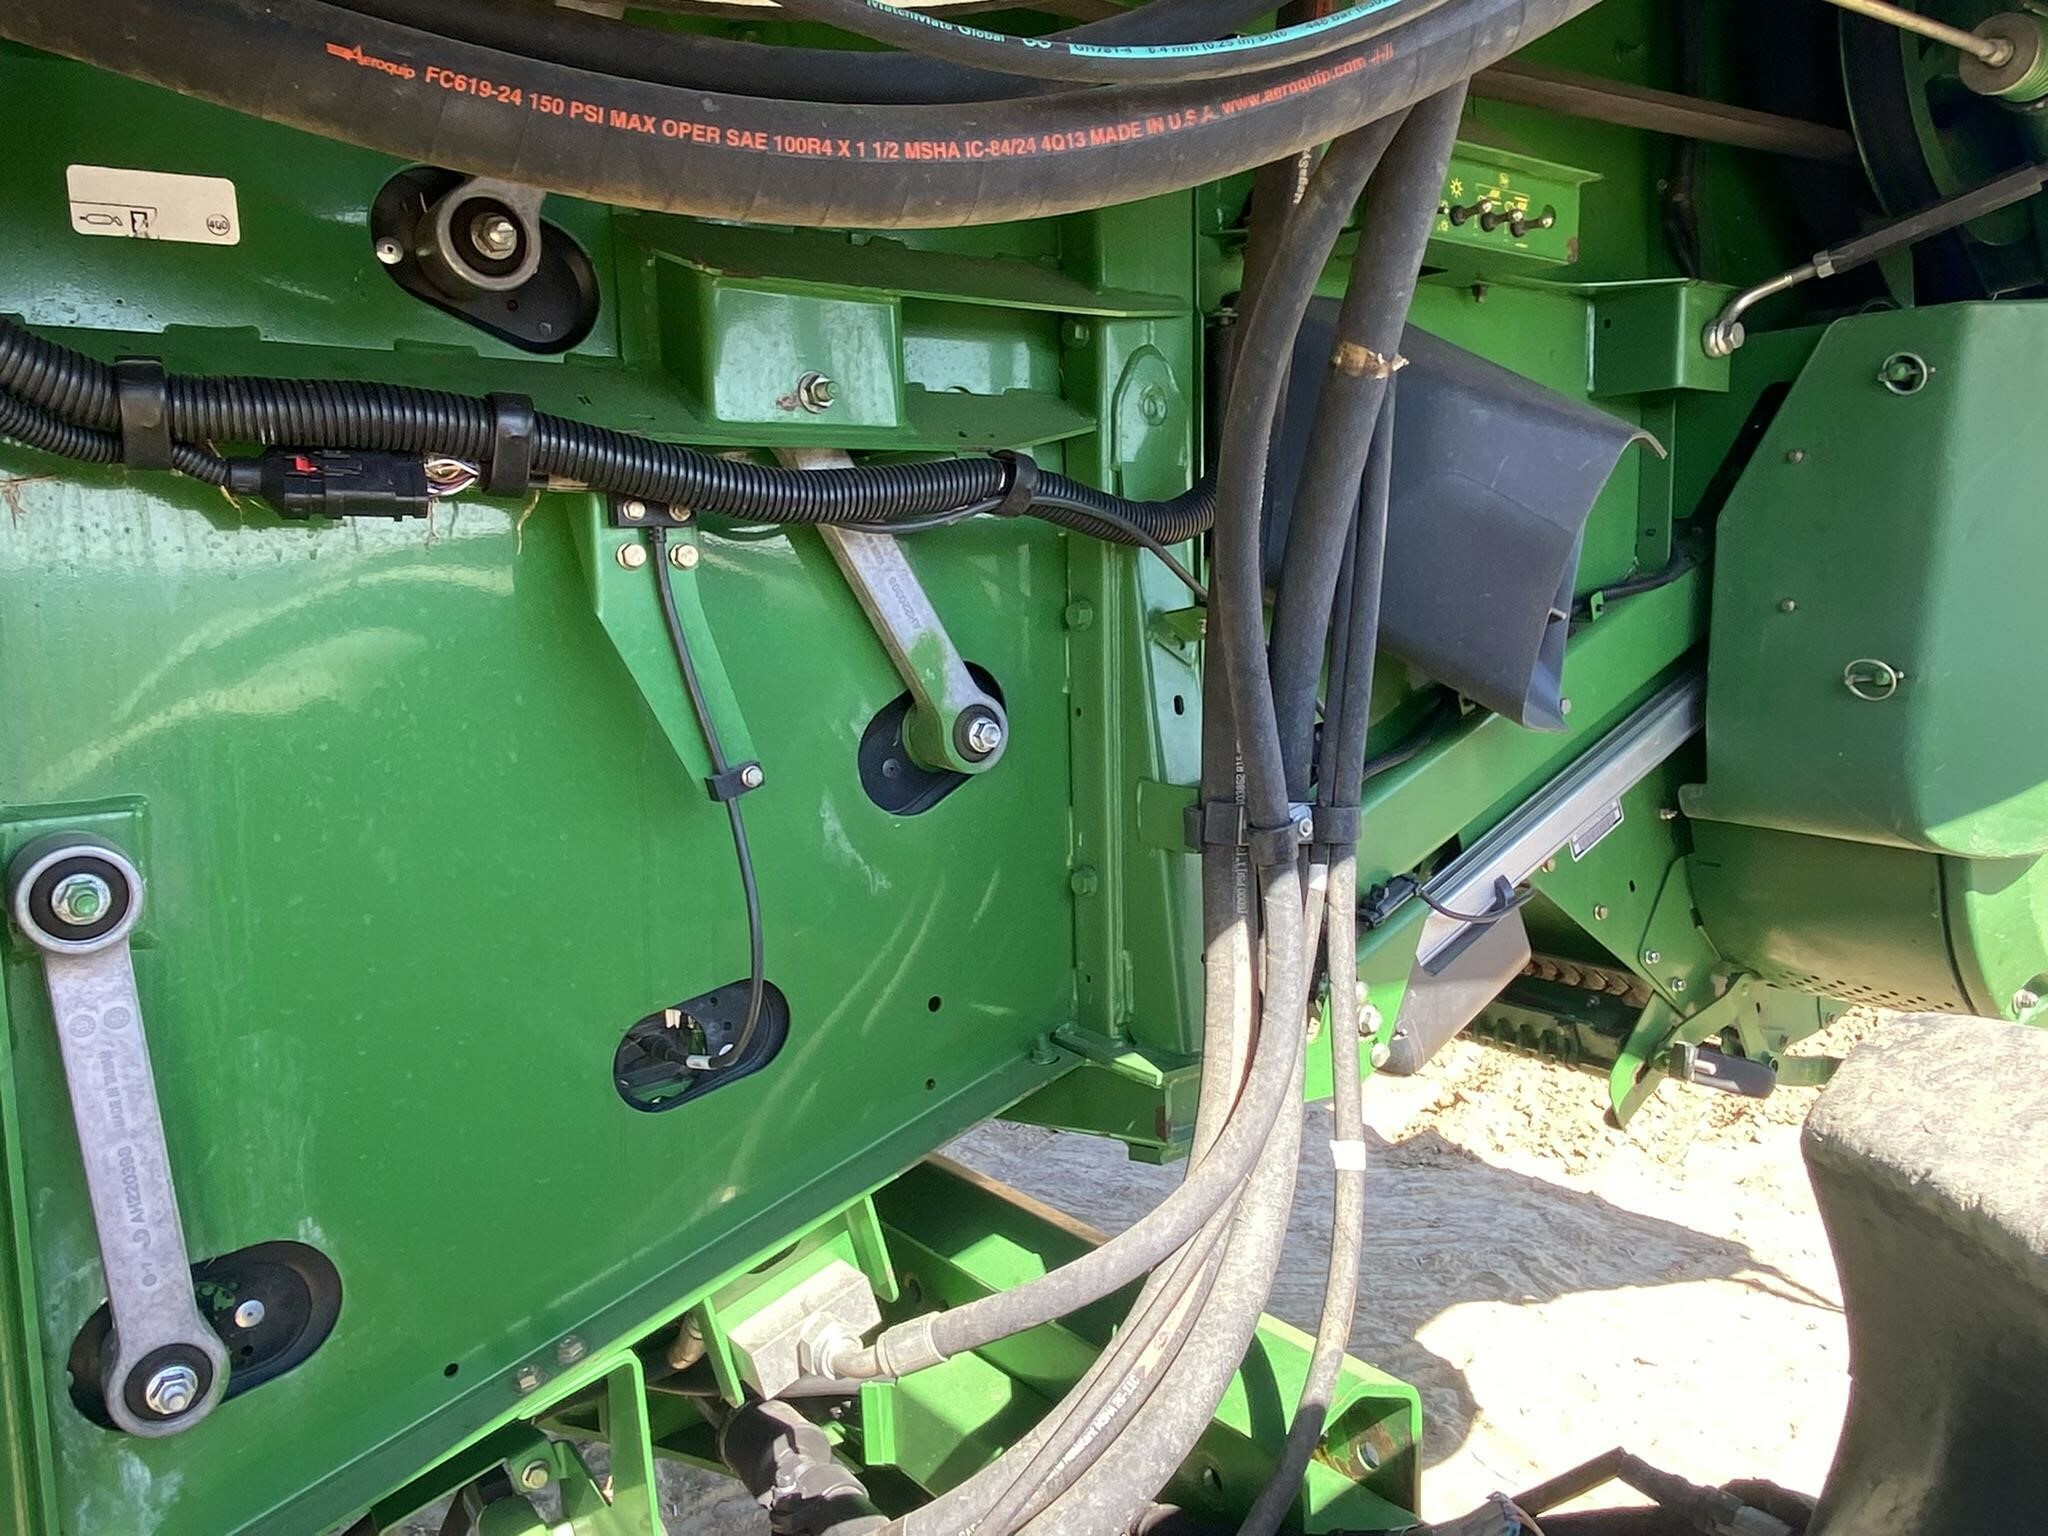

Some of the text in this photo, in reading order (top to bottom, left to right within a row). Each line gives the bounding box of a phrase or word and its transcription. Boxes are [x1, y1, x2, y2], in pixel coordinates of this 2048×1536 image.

[425, 65, 523, 106] FC619-24
[528, 93, 565, 116] 150
[569, 101, 605, 124] PSI
[609, 109, 657, 135] MAX
[662, 118, 721, 145] OPER
[726, 129, 769, 151] SAE
[773, 135, 834, 157] 100R4
[836, 140, 851, 159] X
[856, 141, 866, 159] 1
[872, 141, 900, 159] 1/2
[904, 141, 961, 160] MSHA
[965, 136, 1037, 159] IC-84/24
[1041, 131, 1086, 153] 4Q13
[1090, 121, 1143, 147] MADE
[1146, 116, 1165, 136] IN
[1222, 55, 1368, 115] www.aeroquip.com
